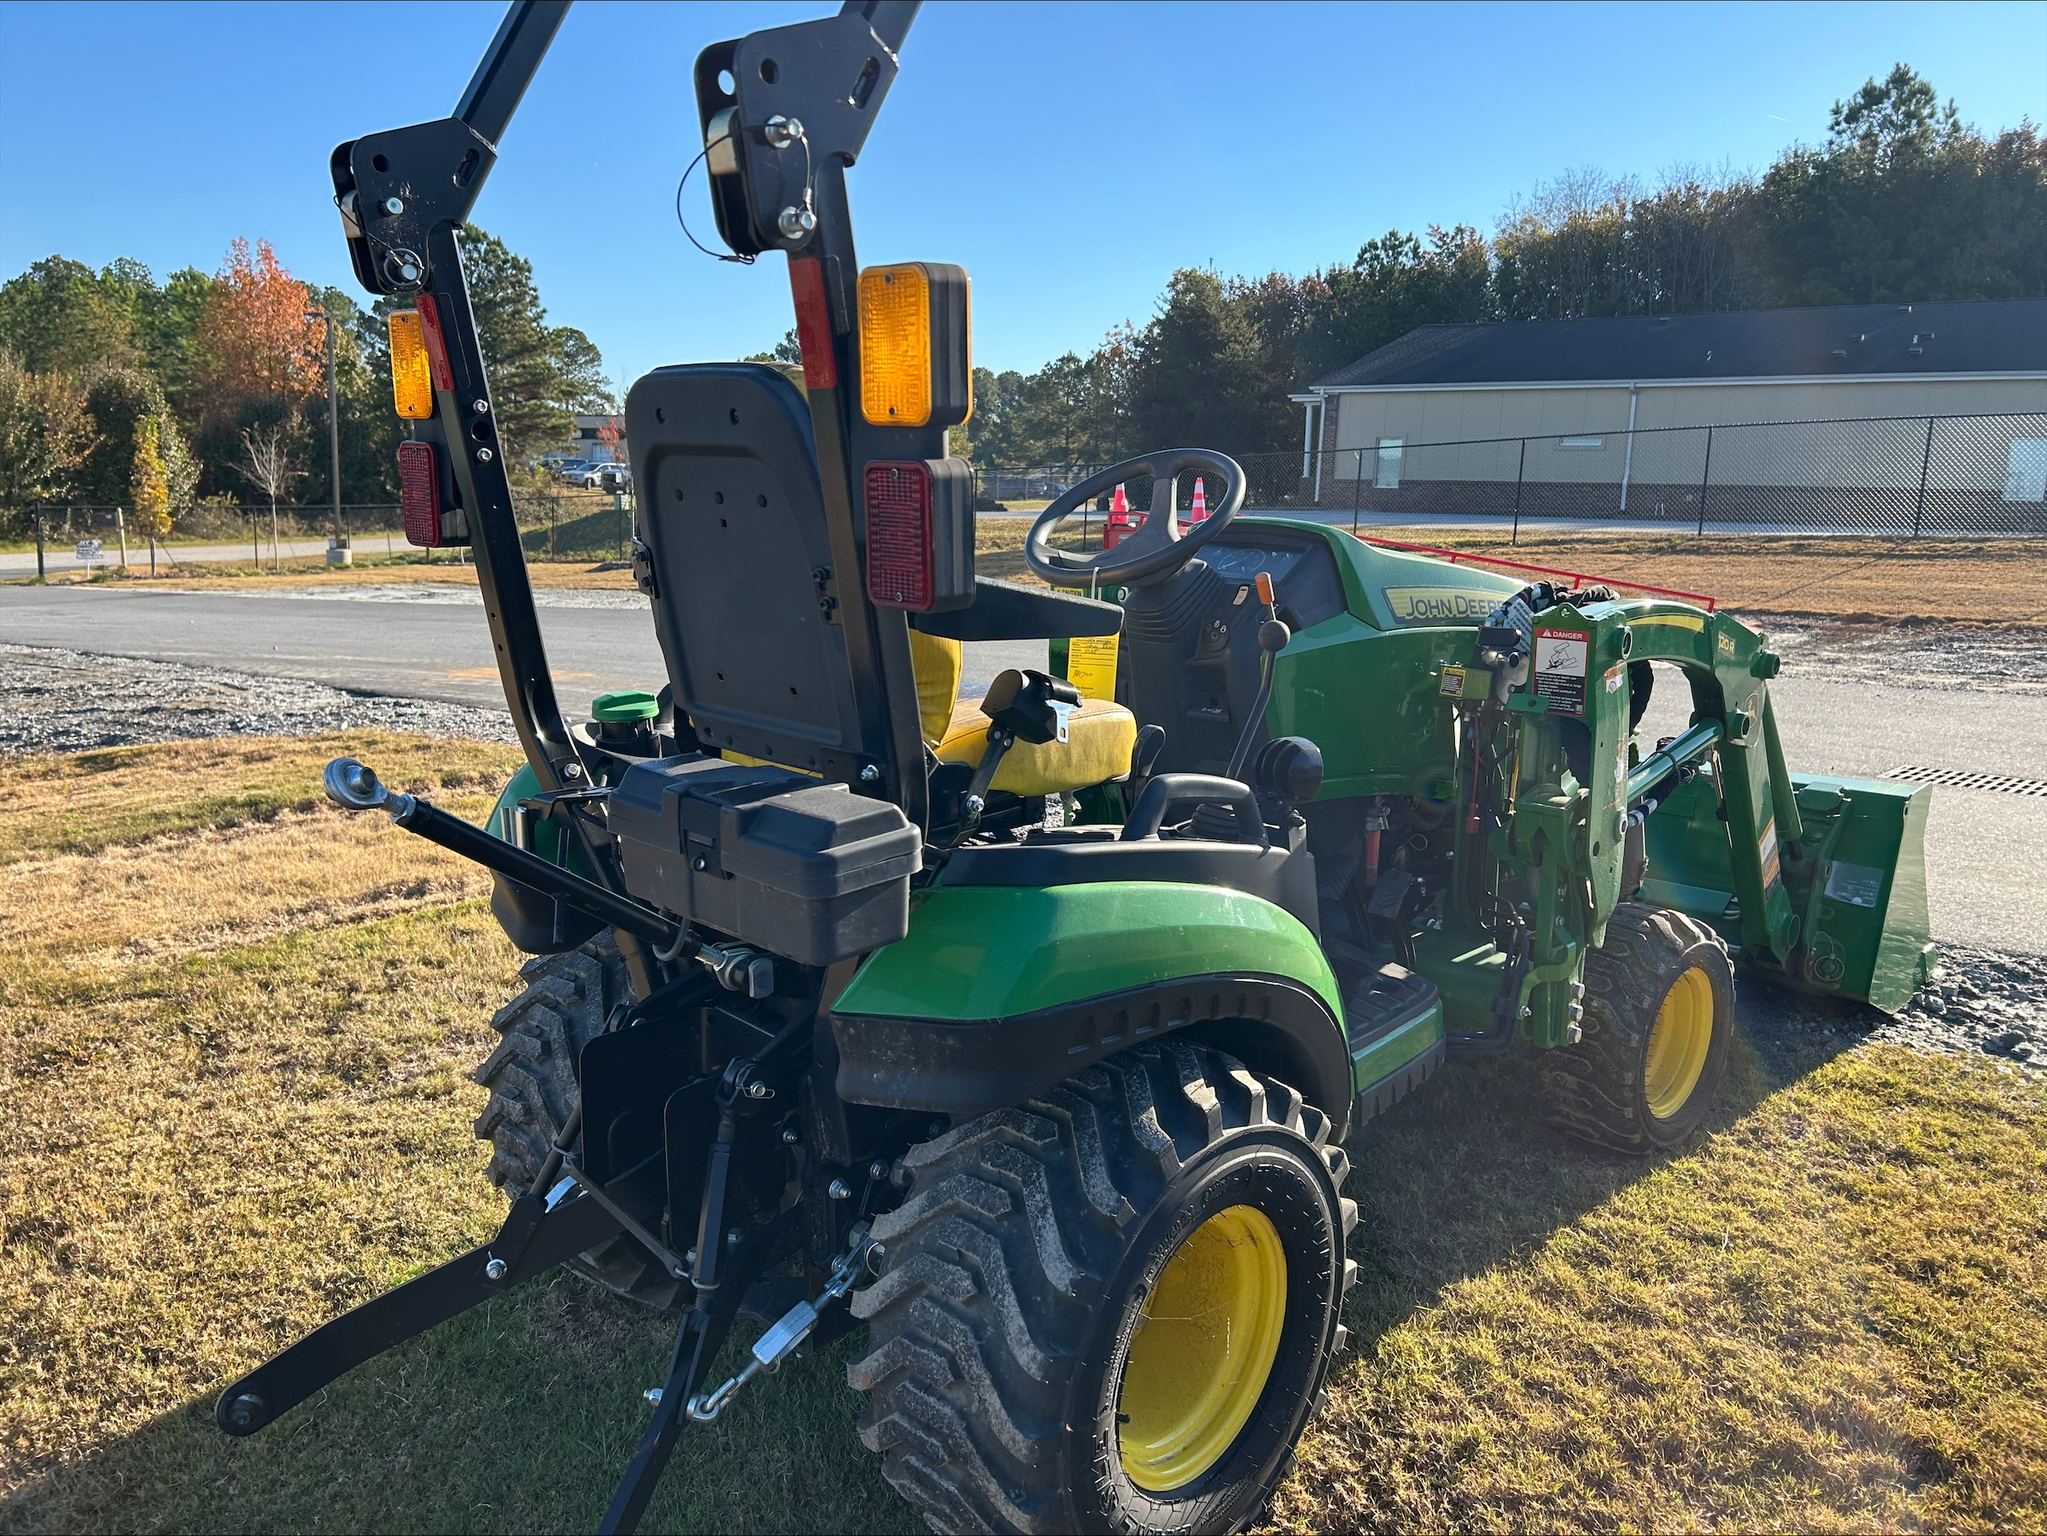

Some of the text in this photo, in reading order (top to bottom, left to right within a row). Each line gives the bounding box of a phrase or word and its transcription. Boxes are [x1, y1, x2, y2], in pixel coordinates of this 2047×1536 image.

[1406, 595, 1503, 617] JOHN DEER
[1552, 631, 1583, 640] DANGER
